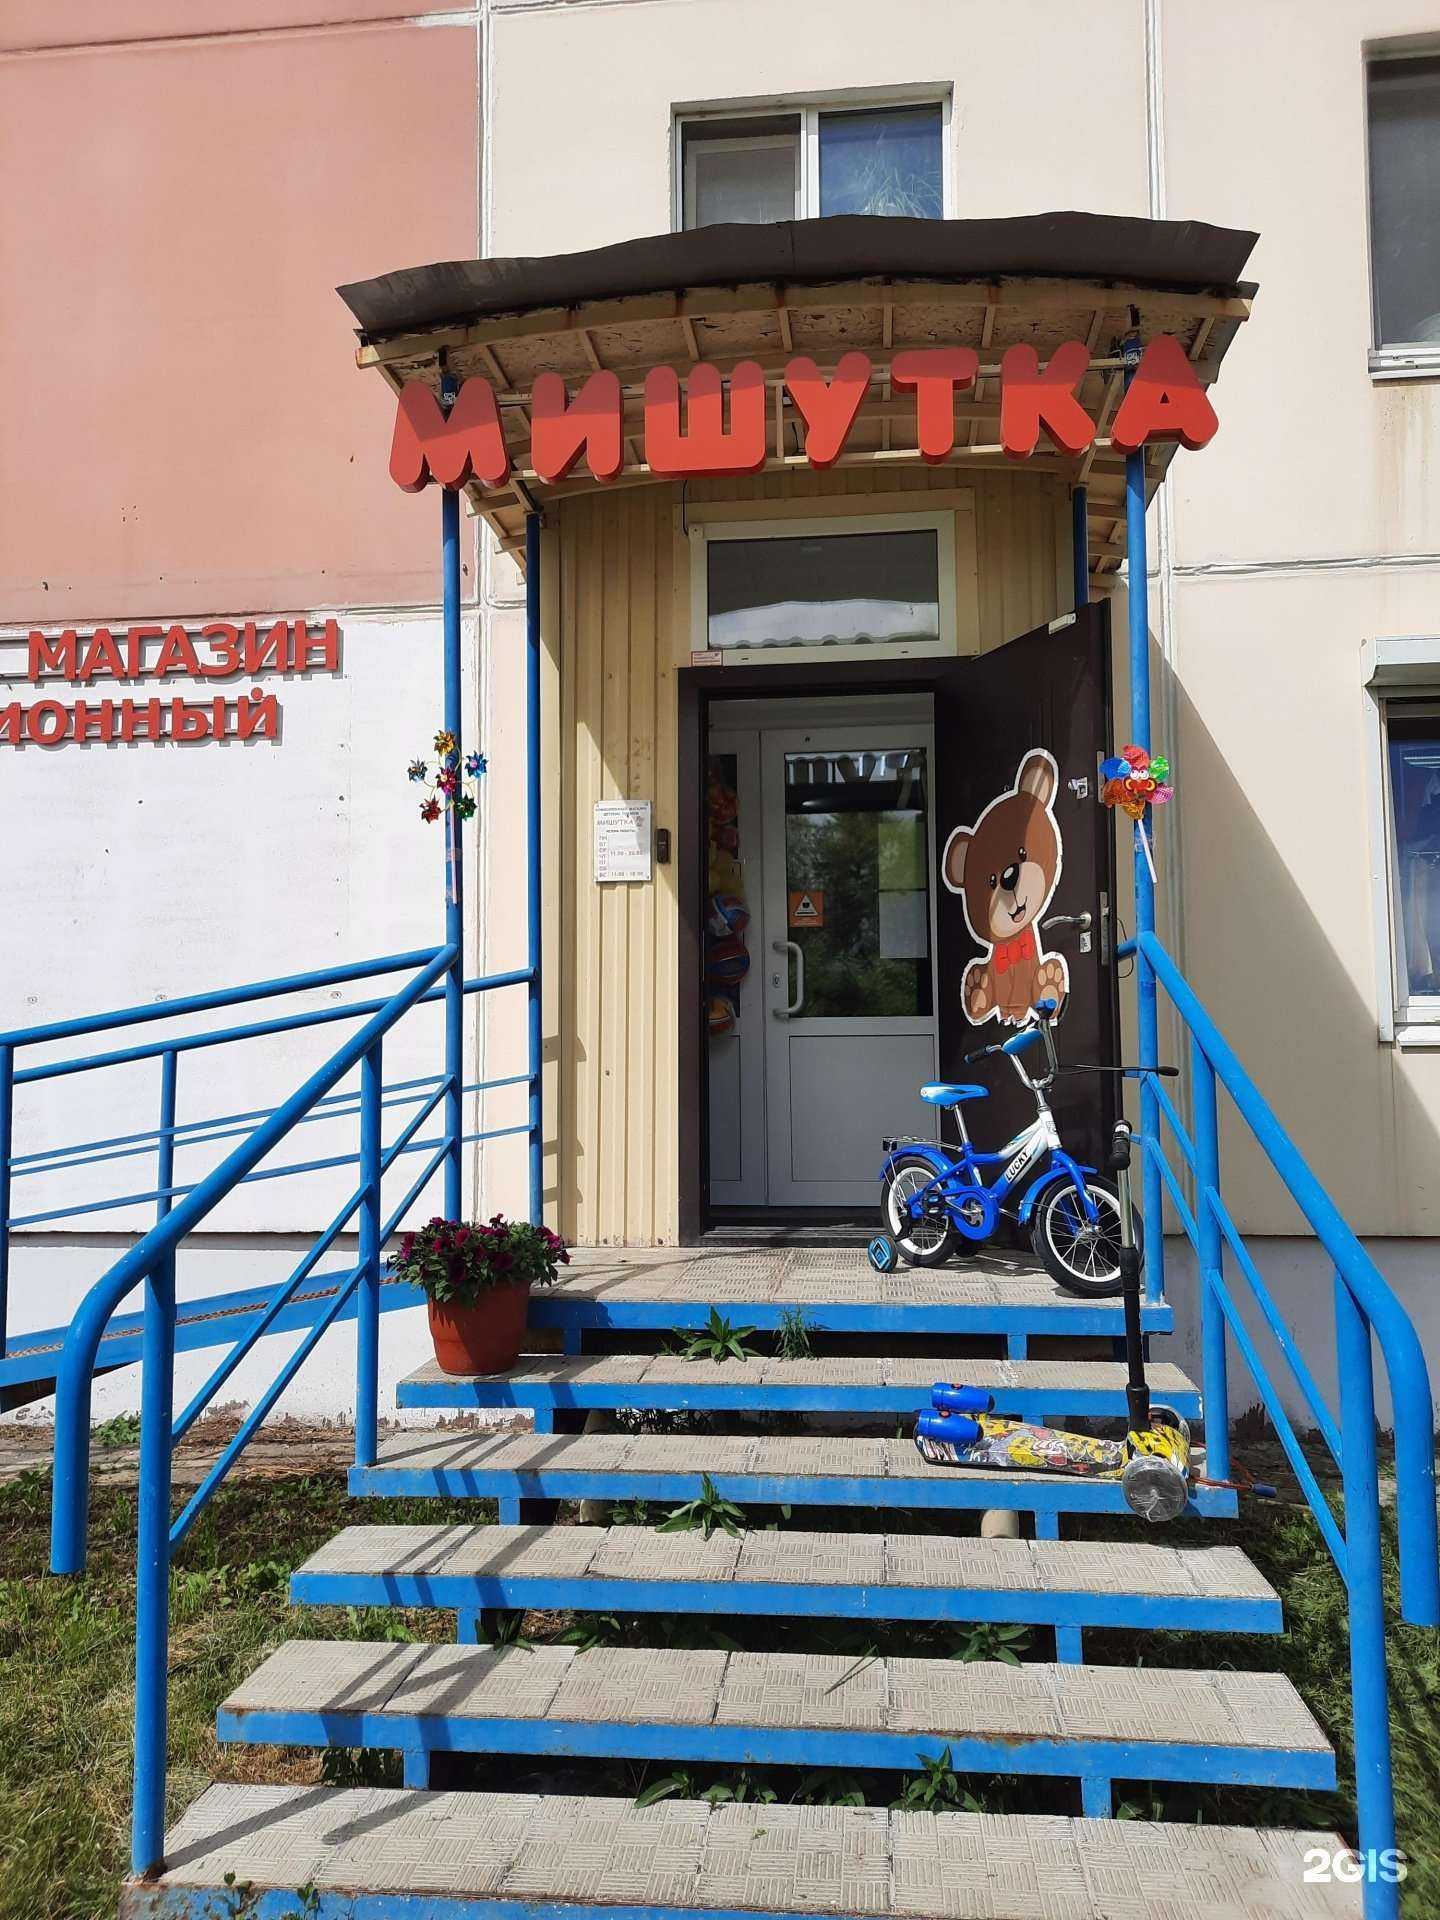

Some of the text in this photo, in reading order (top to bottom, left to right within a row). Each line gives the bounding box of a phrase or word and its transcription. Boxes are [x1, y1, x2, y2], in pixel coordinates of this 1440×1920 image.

[390, 333, 1220, 493] МИШУТКА
[27, 618, 339, 682] МАГАЗИН
[1005, 1148, 1028, 1180] LUCKY
